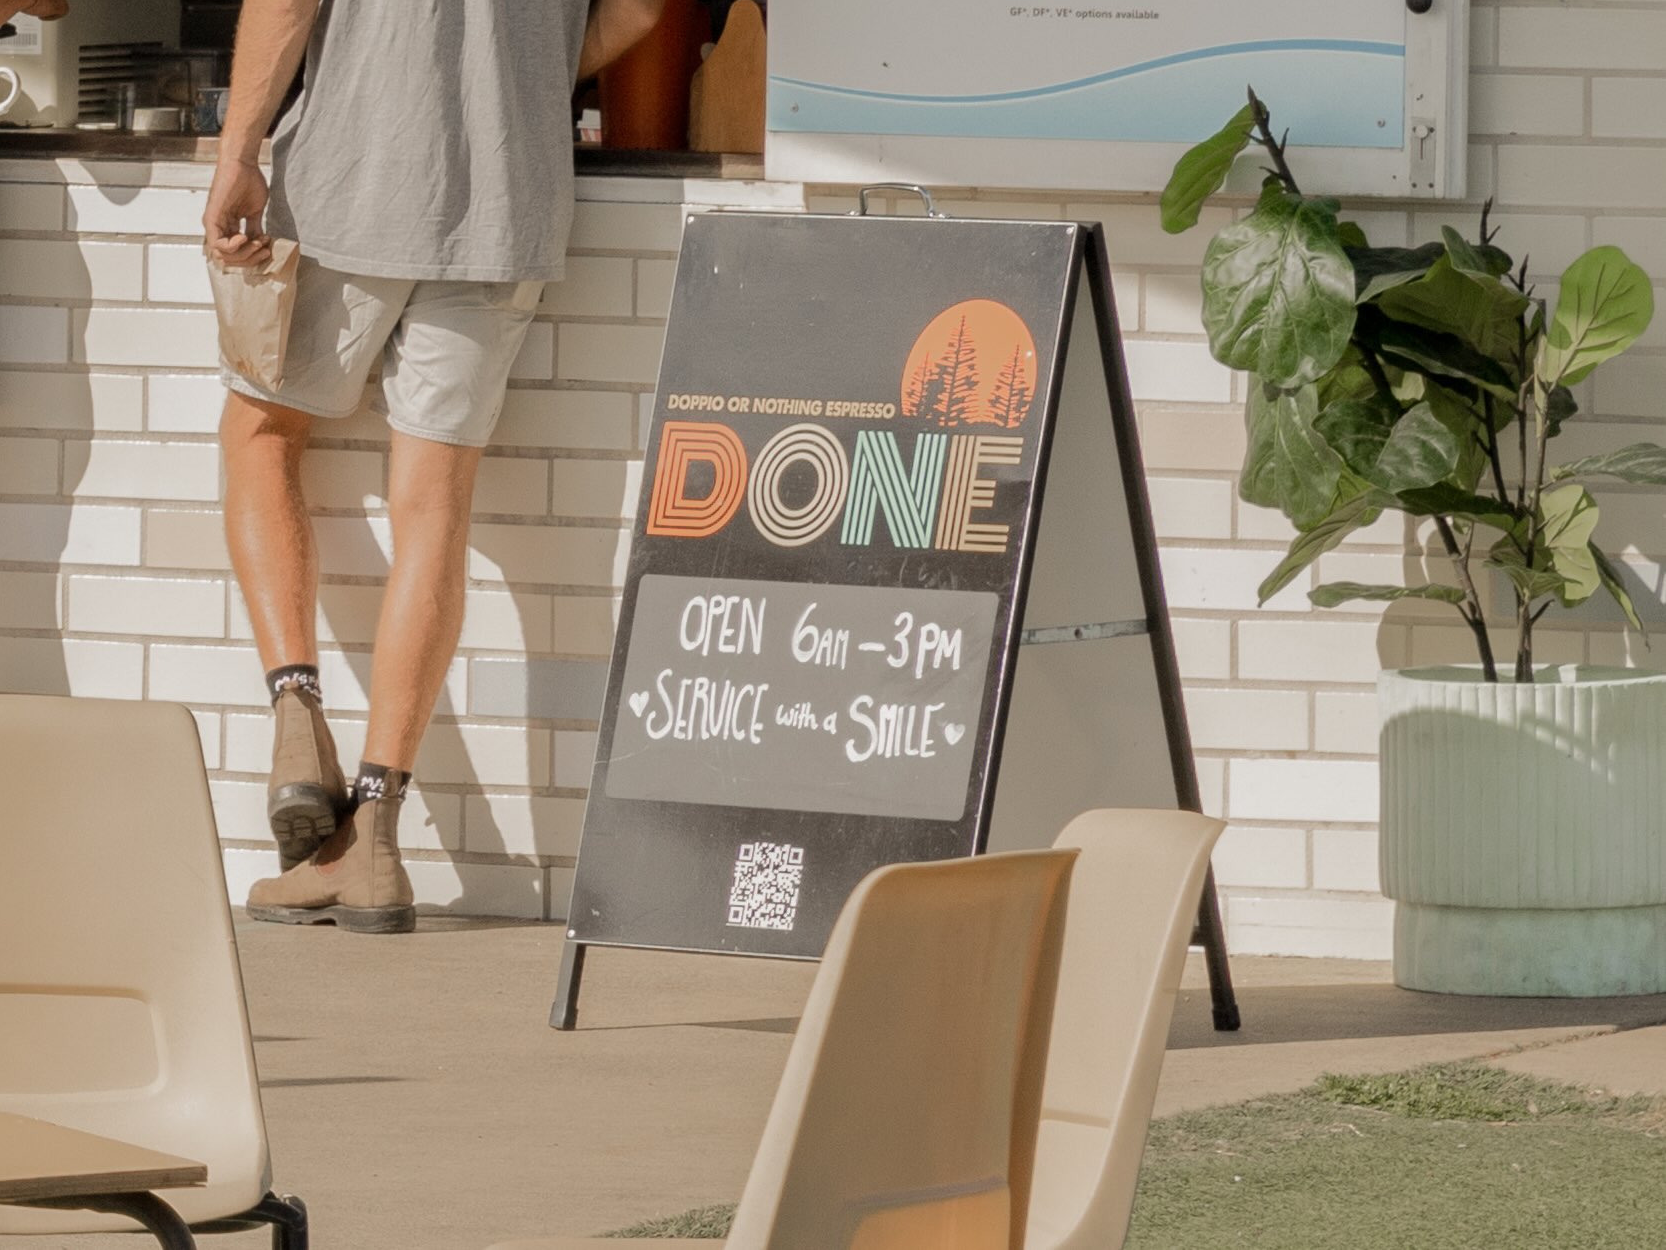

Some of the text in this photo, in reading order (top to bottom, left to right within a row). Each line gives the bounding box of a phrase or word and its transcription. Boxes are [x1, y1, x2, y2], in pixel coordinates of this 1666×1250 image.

[668, 394, 896, 420] DOPPIO OR NOTHING ESPRESSO
[646, 421, 1024, 553] DONE
[679, 595, 766, 657] OPEN
[646, 668, 946, 763] SERVICE with a SMILE
